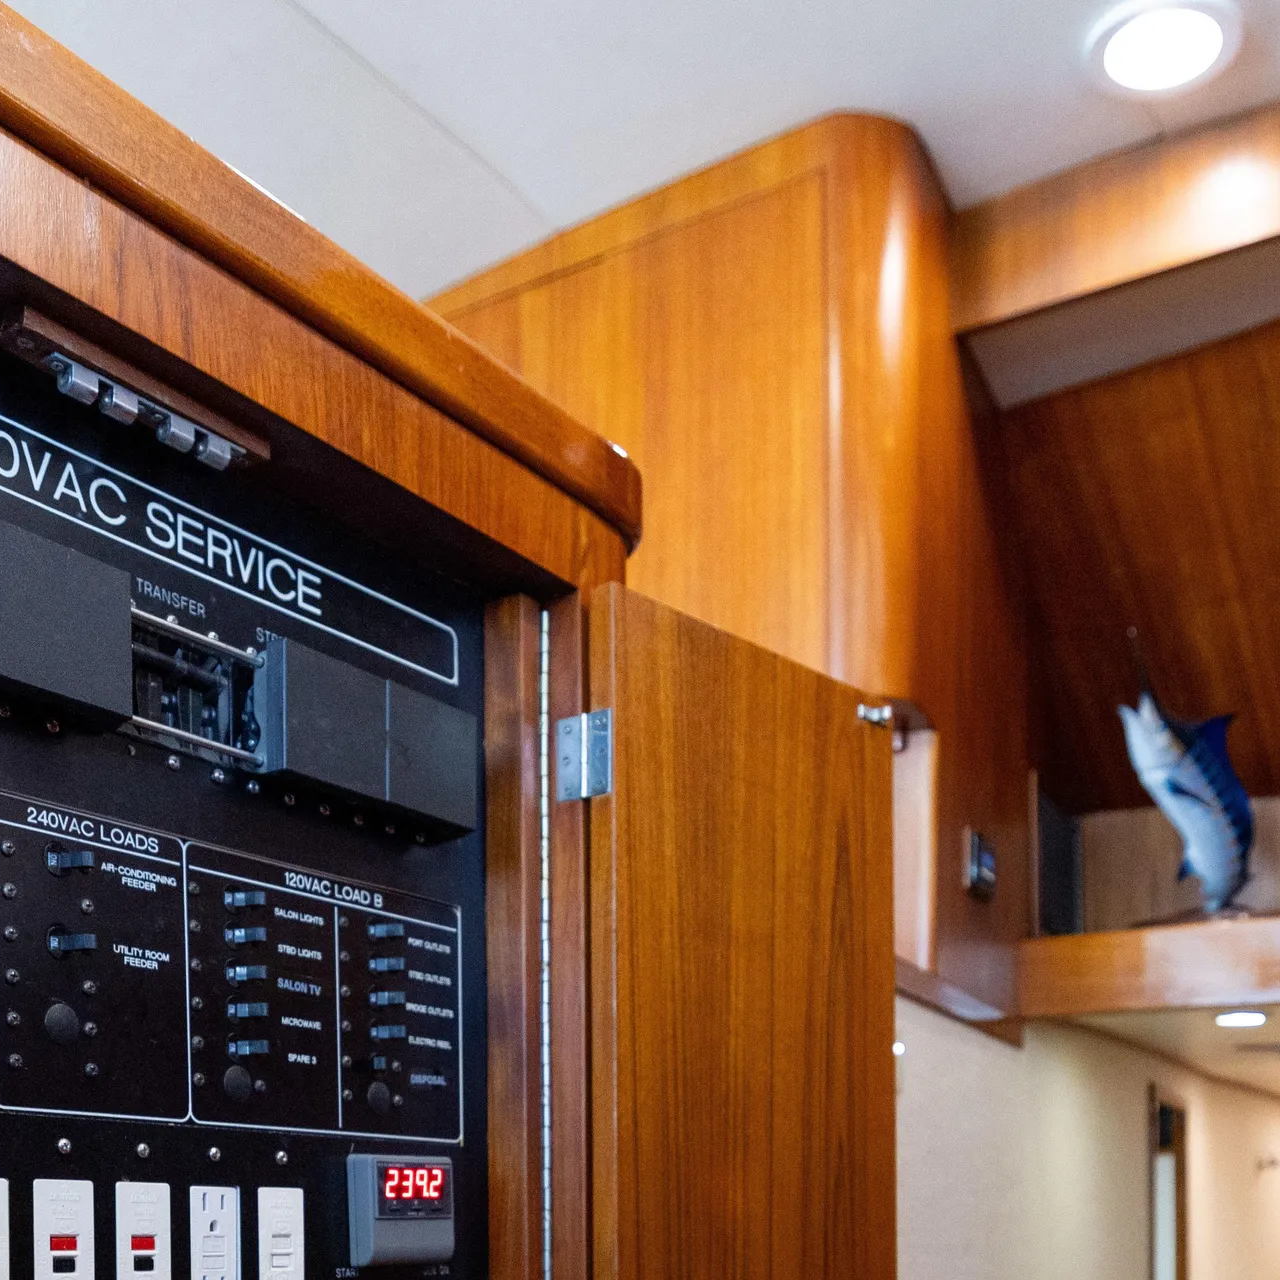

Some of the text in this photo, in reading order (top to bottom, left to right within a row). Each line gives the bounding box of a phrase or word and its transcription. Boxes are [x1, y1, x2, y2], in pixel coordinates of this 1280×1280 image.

[146, 501, 323, 616] SERVICE
[136, 577, 206, 618] TRANSFER
[26, 806, 159, 853] 240VAC LOADS
[100, 861, 177, 887] AIR-CONDITIONING
[121, 876, 157, 893] FEEDER
[283, 871, 384, 908] 120VAC LOAD B
[273, 907, 325, 926] SALON LIGHTS
[113, 943, 170, 962] UTILITY ROOM
[277, 944, 323, 961] STBD LIGHTS
[123, 956, 159, 970] FEEDER
[277, 977, 322, 996] SALON TV
[281, 1016, 322, 1030] MICROWAVE
[287, 1053, 311, 1064] SPARE
[385, 1169, 443, 1198] 239.2
